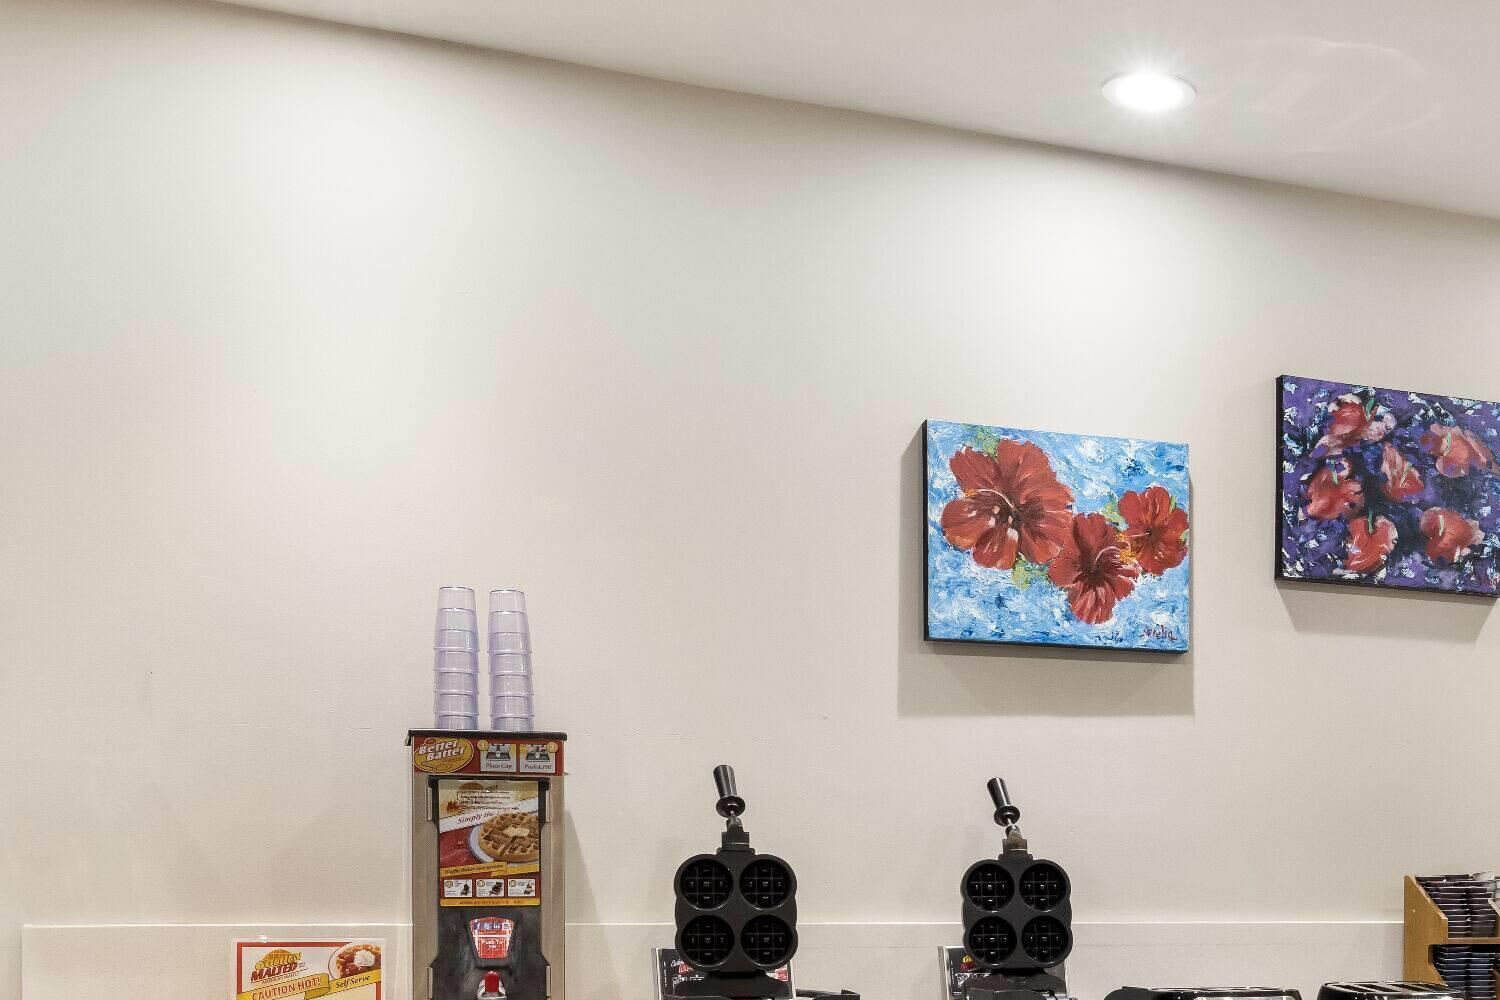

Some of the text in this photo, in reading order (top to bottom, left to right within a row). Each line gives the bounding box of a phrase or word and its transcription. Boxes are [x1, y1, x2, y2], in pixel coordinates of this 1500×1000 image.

[419, 740, 459, 754] Better
[427, 746, 466, 761] Batter
[251, 962, 298, 981] MALTED
[297, 977, 321, 991] HOT!
[335, 975, 371, 989] Self Serve
